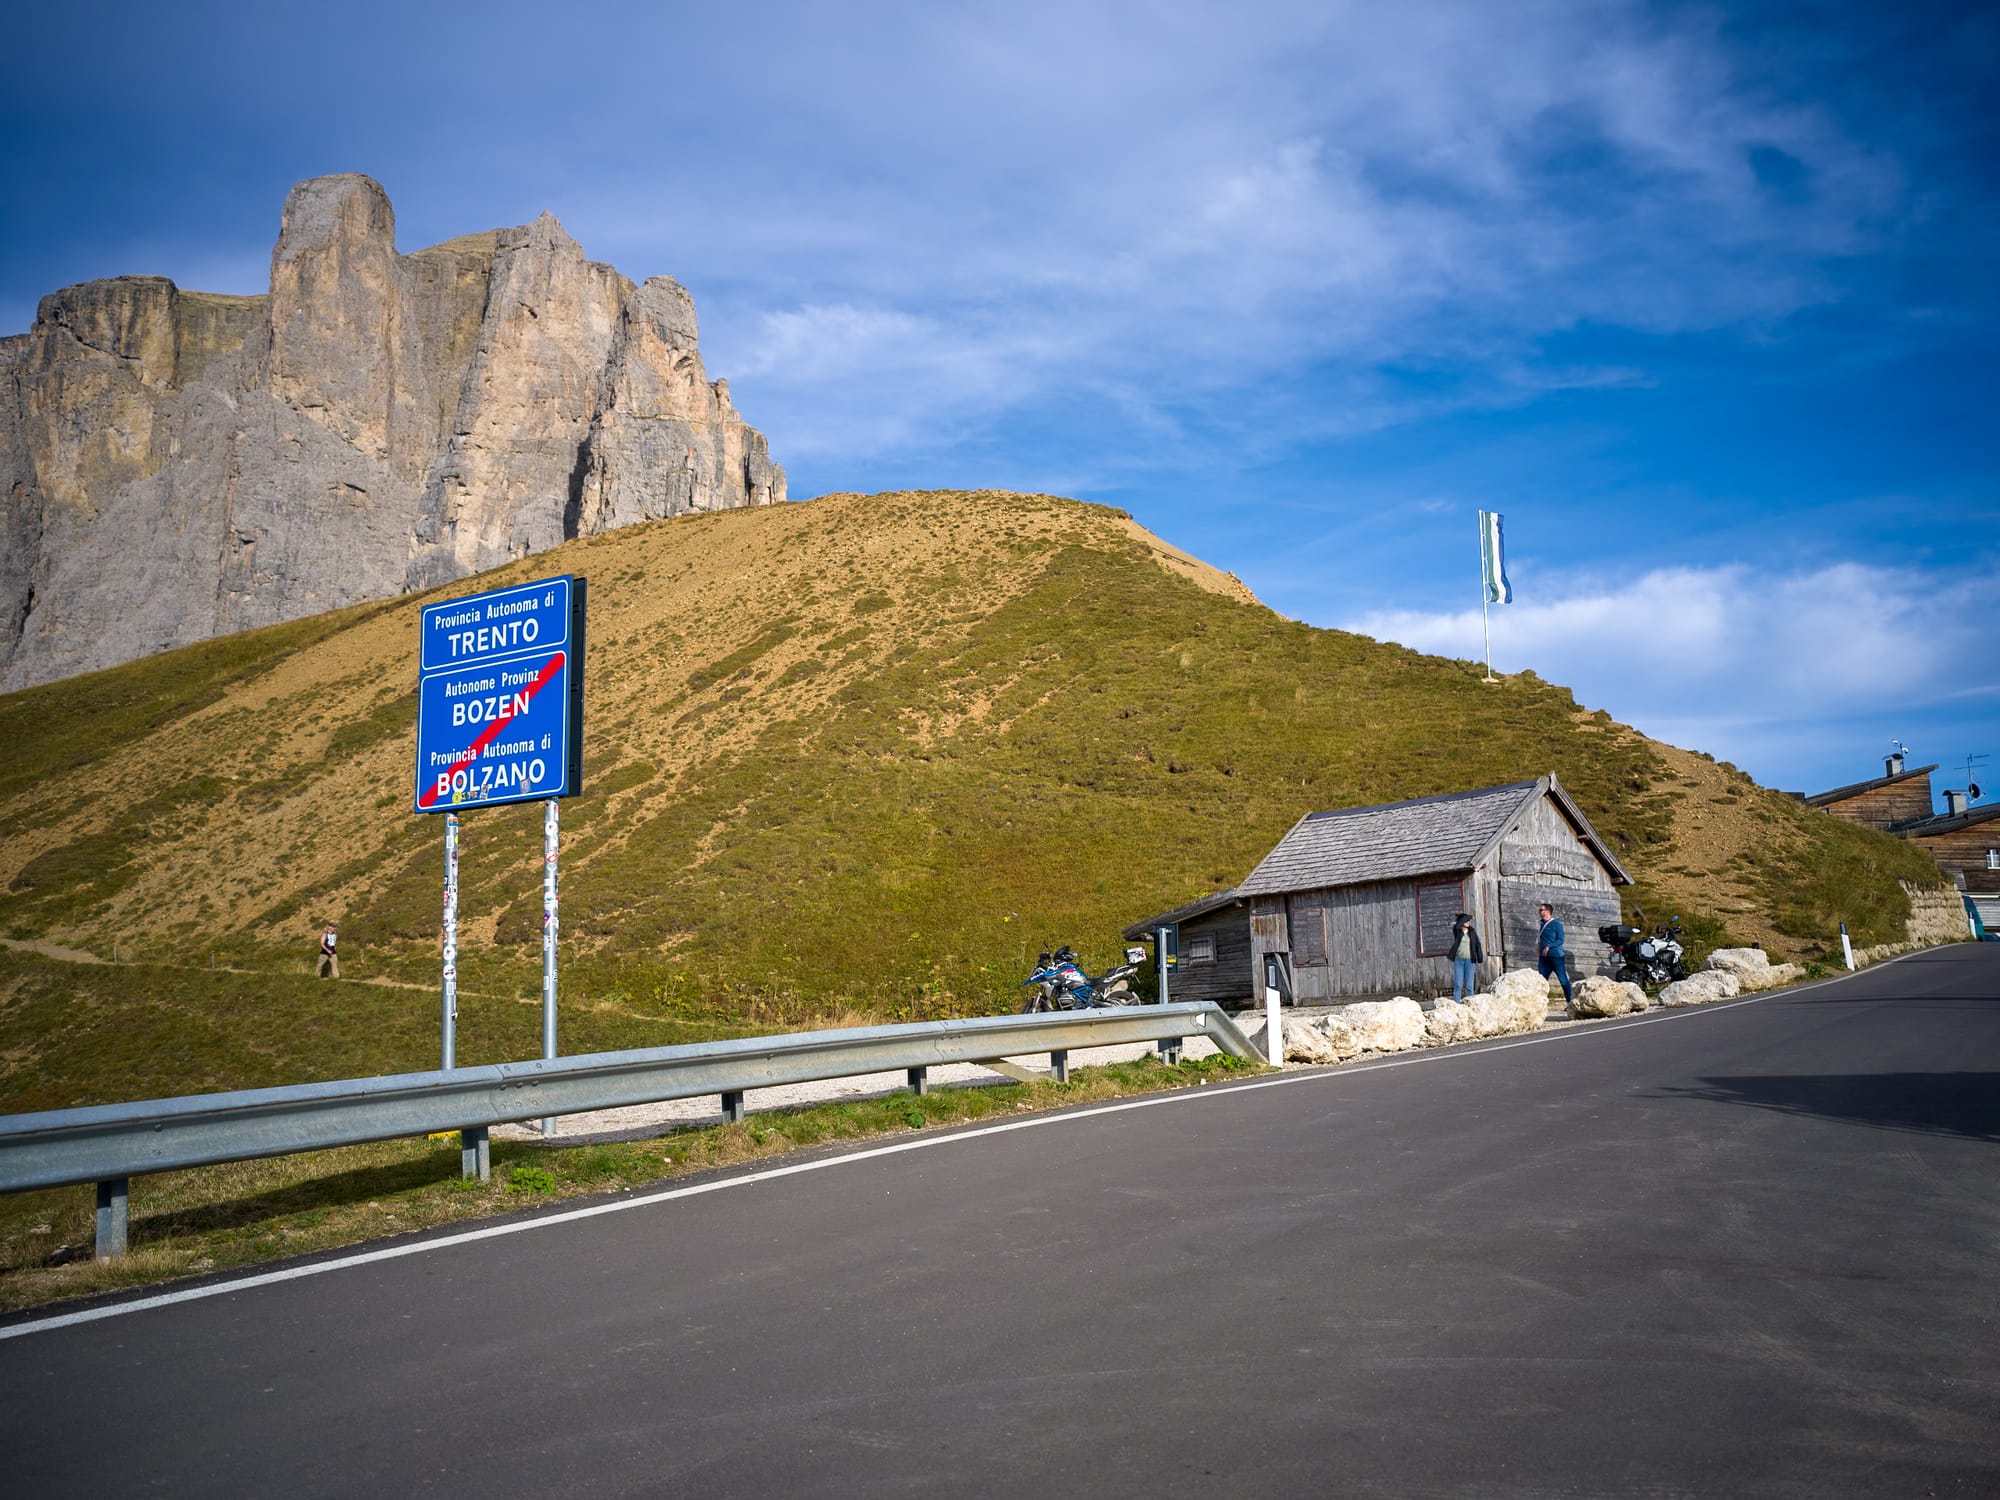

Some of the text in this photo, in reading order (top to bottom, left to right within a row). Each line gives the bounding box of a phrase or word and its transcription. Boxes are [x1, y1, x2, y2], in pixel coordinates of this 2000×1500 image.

[436, 592, 554, 630] Provincia Autonoma di
[448, 619, 539, 656] TRENTO
[445, 669, 539, 697] Autonome Provinz
[453, 692, 529, 726] BOZEN
[431, 734, 551, 766] Provincia Autonoma di
[437, 759, 545, 796] BOLZANO
